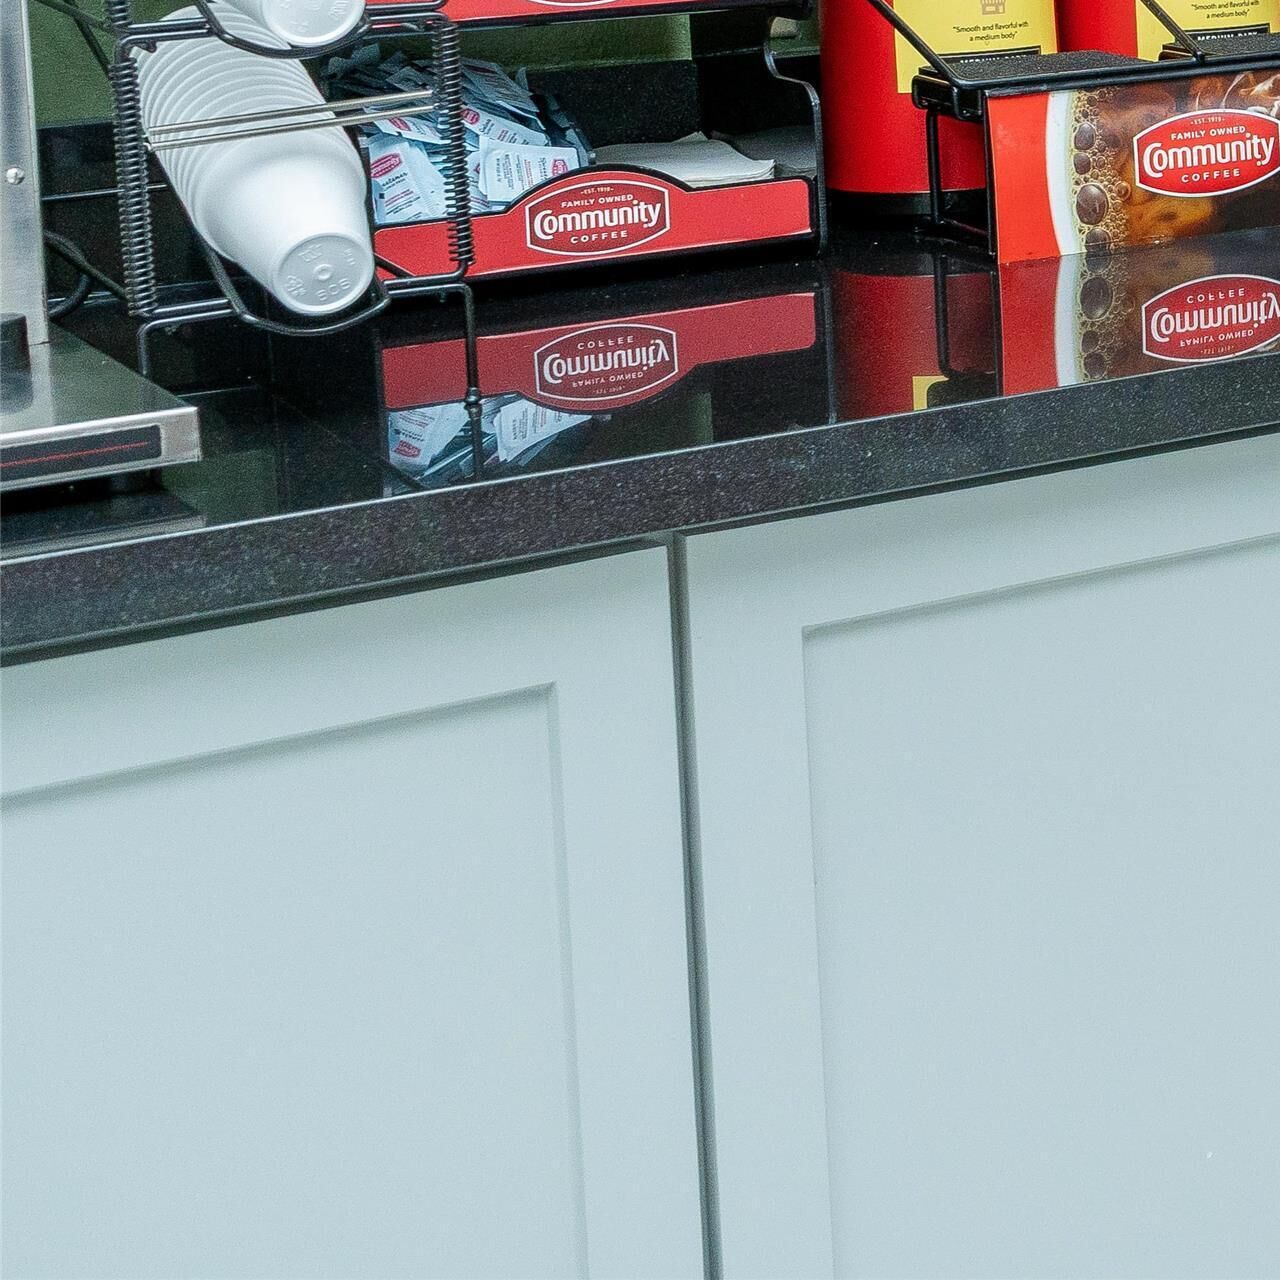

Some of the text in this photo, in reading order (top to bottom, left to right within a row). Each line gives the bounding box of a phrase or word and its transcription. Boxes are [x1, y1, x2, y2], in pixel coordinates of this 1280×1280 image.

[982, 23, 994, 32] and
[994, 21, 1018, 31] flavorful
[1018, 20, 1029, 29] with
[974, 33, 1000, 41] medium
[1170, 125, 1246, 140] FAMILY OWNED
[1143, 132, 1275, 178] Community
[1181, 168, 1240, 183] COFFEE
[560, 194, 633, 208] FAMILY OWNED
[534, 200, 661, 240] Community
[570, 230, 628, 244] COFFEE
